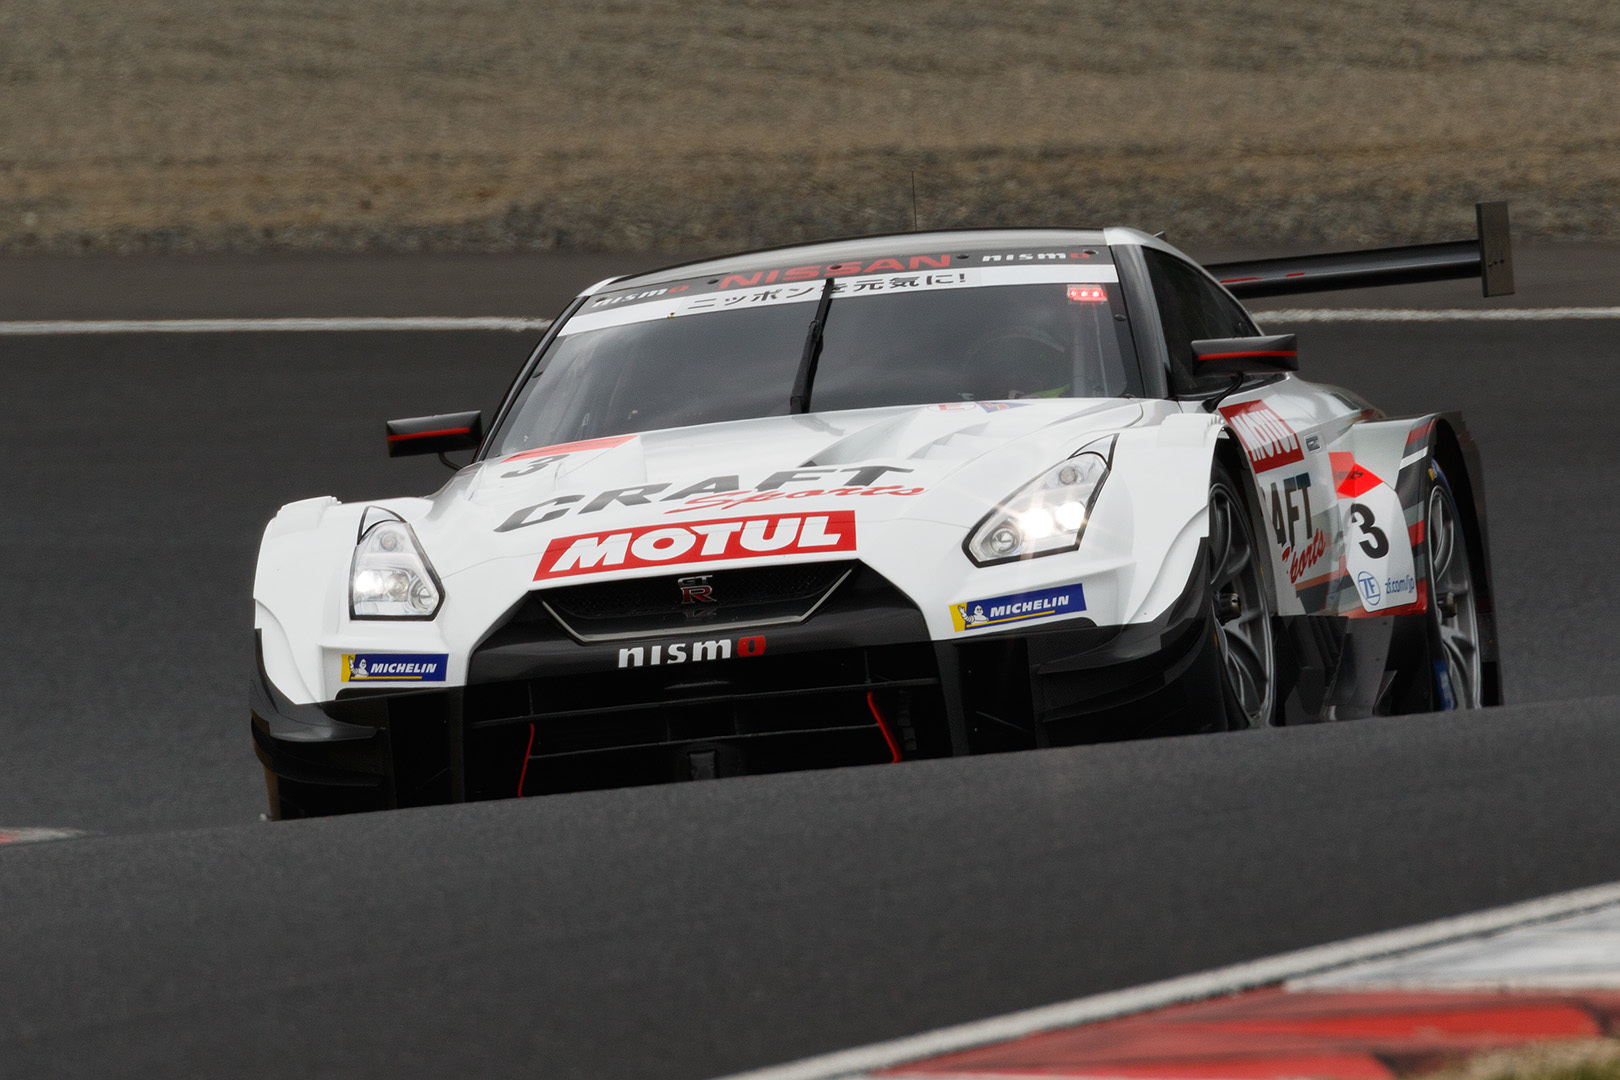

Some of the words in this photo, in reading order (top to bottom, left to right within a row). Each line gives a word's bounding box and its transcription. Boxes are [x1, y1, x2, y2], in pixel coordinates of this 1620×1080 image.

[982, 252, 1091, 262] nismo
[718, 254, 950, 290] NISSAN
[591, 285, 689, 308] nismo
[500, 454, 570, 478] 3
[493, 465, 915, 533] CRAFT
[664, 485, 929, 514] Sports
[549, 515, 842, 572] MOTUL
[1350, 503, 1389, 559] 3
[990, 595, 1069, 617] MICHELIN
[618, 635, 766, 668] nismo
[370, 663, 437, 674] MICHELIN
